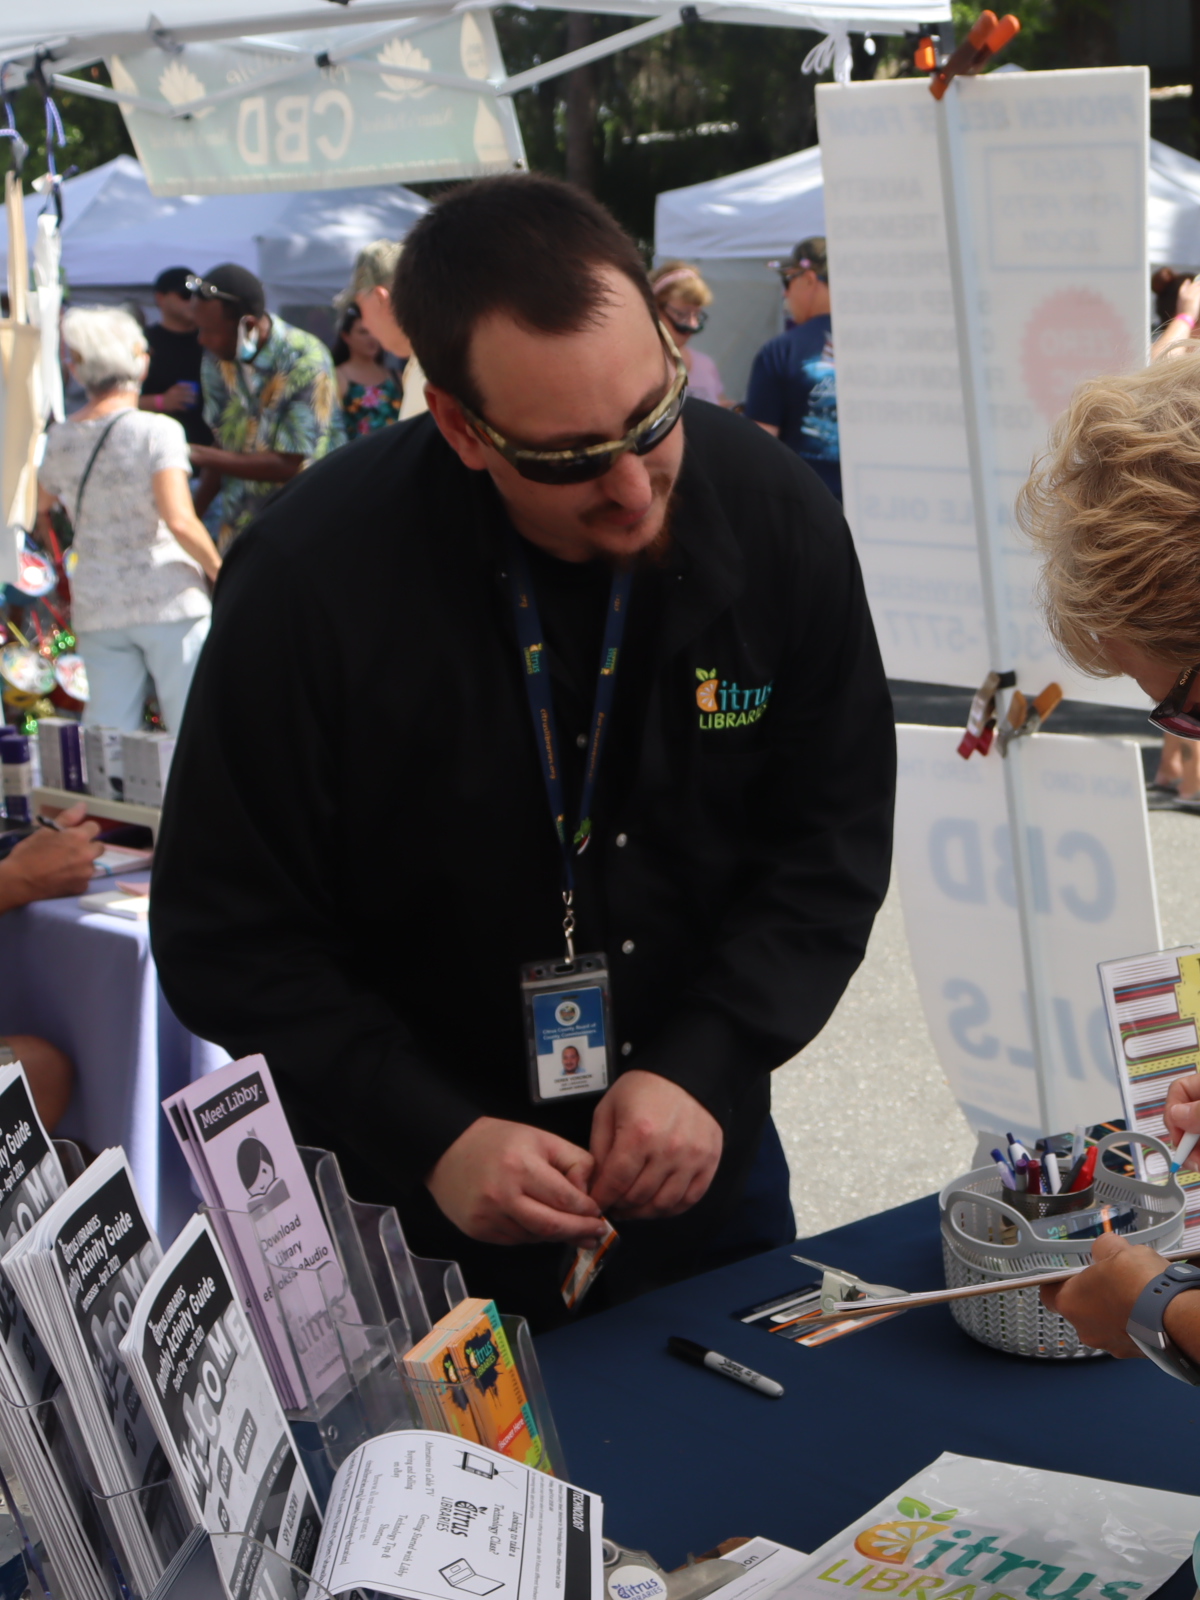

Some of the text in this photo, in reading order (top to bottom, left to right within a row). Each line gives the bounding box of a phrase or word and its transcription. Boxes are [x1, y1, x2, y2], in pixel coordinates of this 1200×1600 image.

[200, 1102, 228, 1130] Meet
[5, 1119, 32, 1154] Guide
[79, 1211, 133, 1283] Activity Guide
[260, 1214, 303, 1253] Download
[275, 1240, 304, 1267] Library
[298, 1244, 329, 1278] eAudio
[163, 1284, 188, 1323] LIBRARIES
[166, 1307, 194, 1358] Activity
[188, 1276, 216, 1315] Guide
[182, 1301, 251, 1496] WELCOME
[237, 1419, 255, 1467] LIBRARY
[436, 1496, 453, 1533] LIBRARIES
[488, 1503, 503, 1535] Technology
[509, 1511, 522, 1532] Looking
[571, 1490, 585, 1533] TECHNOLOGY
[509, 1541, 520, 1552] take
[617, 1578, 660, 1600] Citrus
